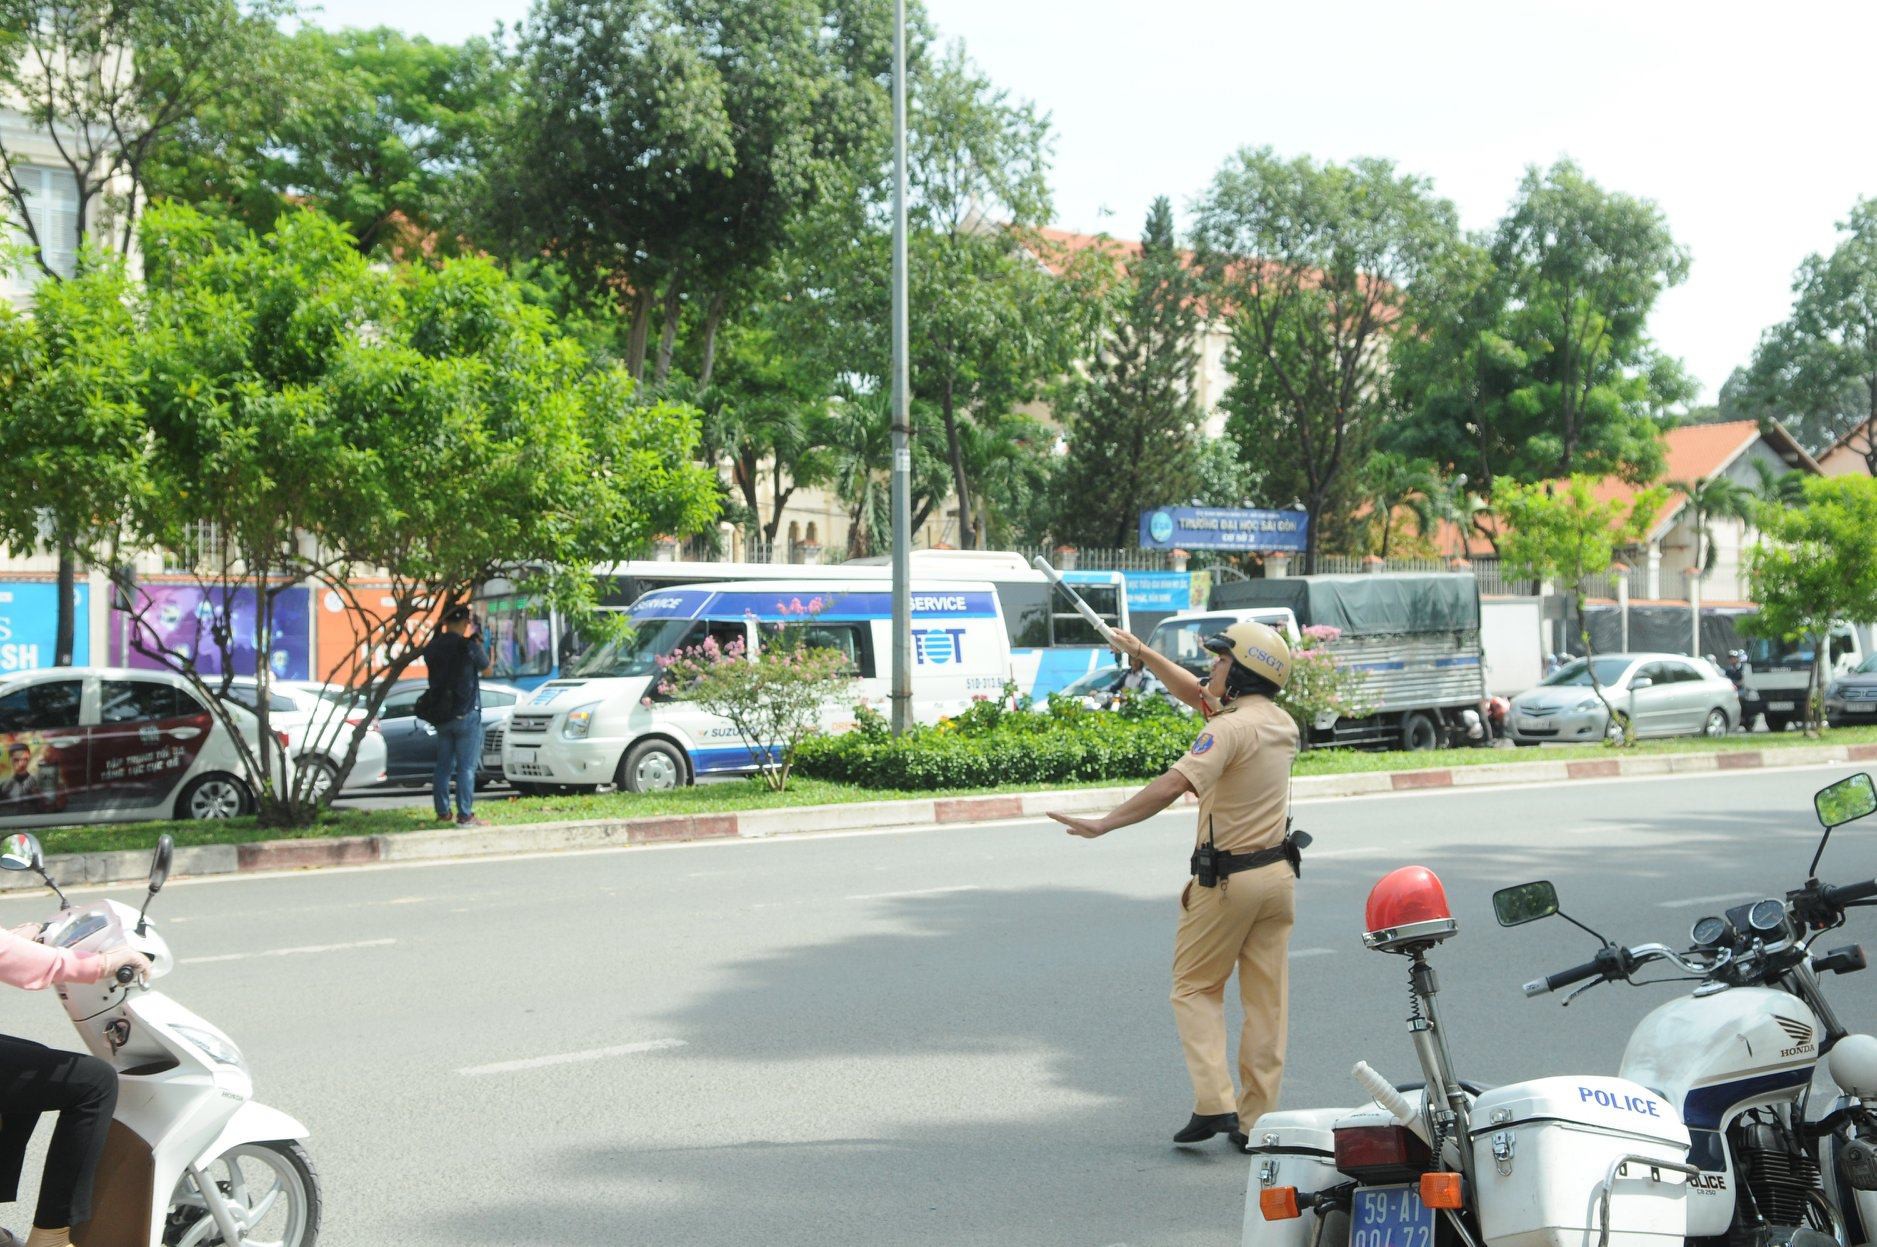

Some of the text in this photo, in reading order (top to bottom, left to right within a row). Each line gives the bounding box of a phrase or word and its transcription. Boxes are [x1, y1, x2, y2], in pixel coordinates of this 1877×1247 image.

[910, 596, 967, 611] SERVICE
[1248, 646, 1284, 671] CSGT
[1780, 1044, 1815, 1057] HONDA
[1578, 1087, 1660, 1117] POLICE
[1687, 1175, 1727, 1189] OLICE
[1365, 1191, 1420, 1224] 59-A1
